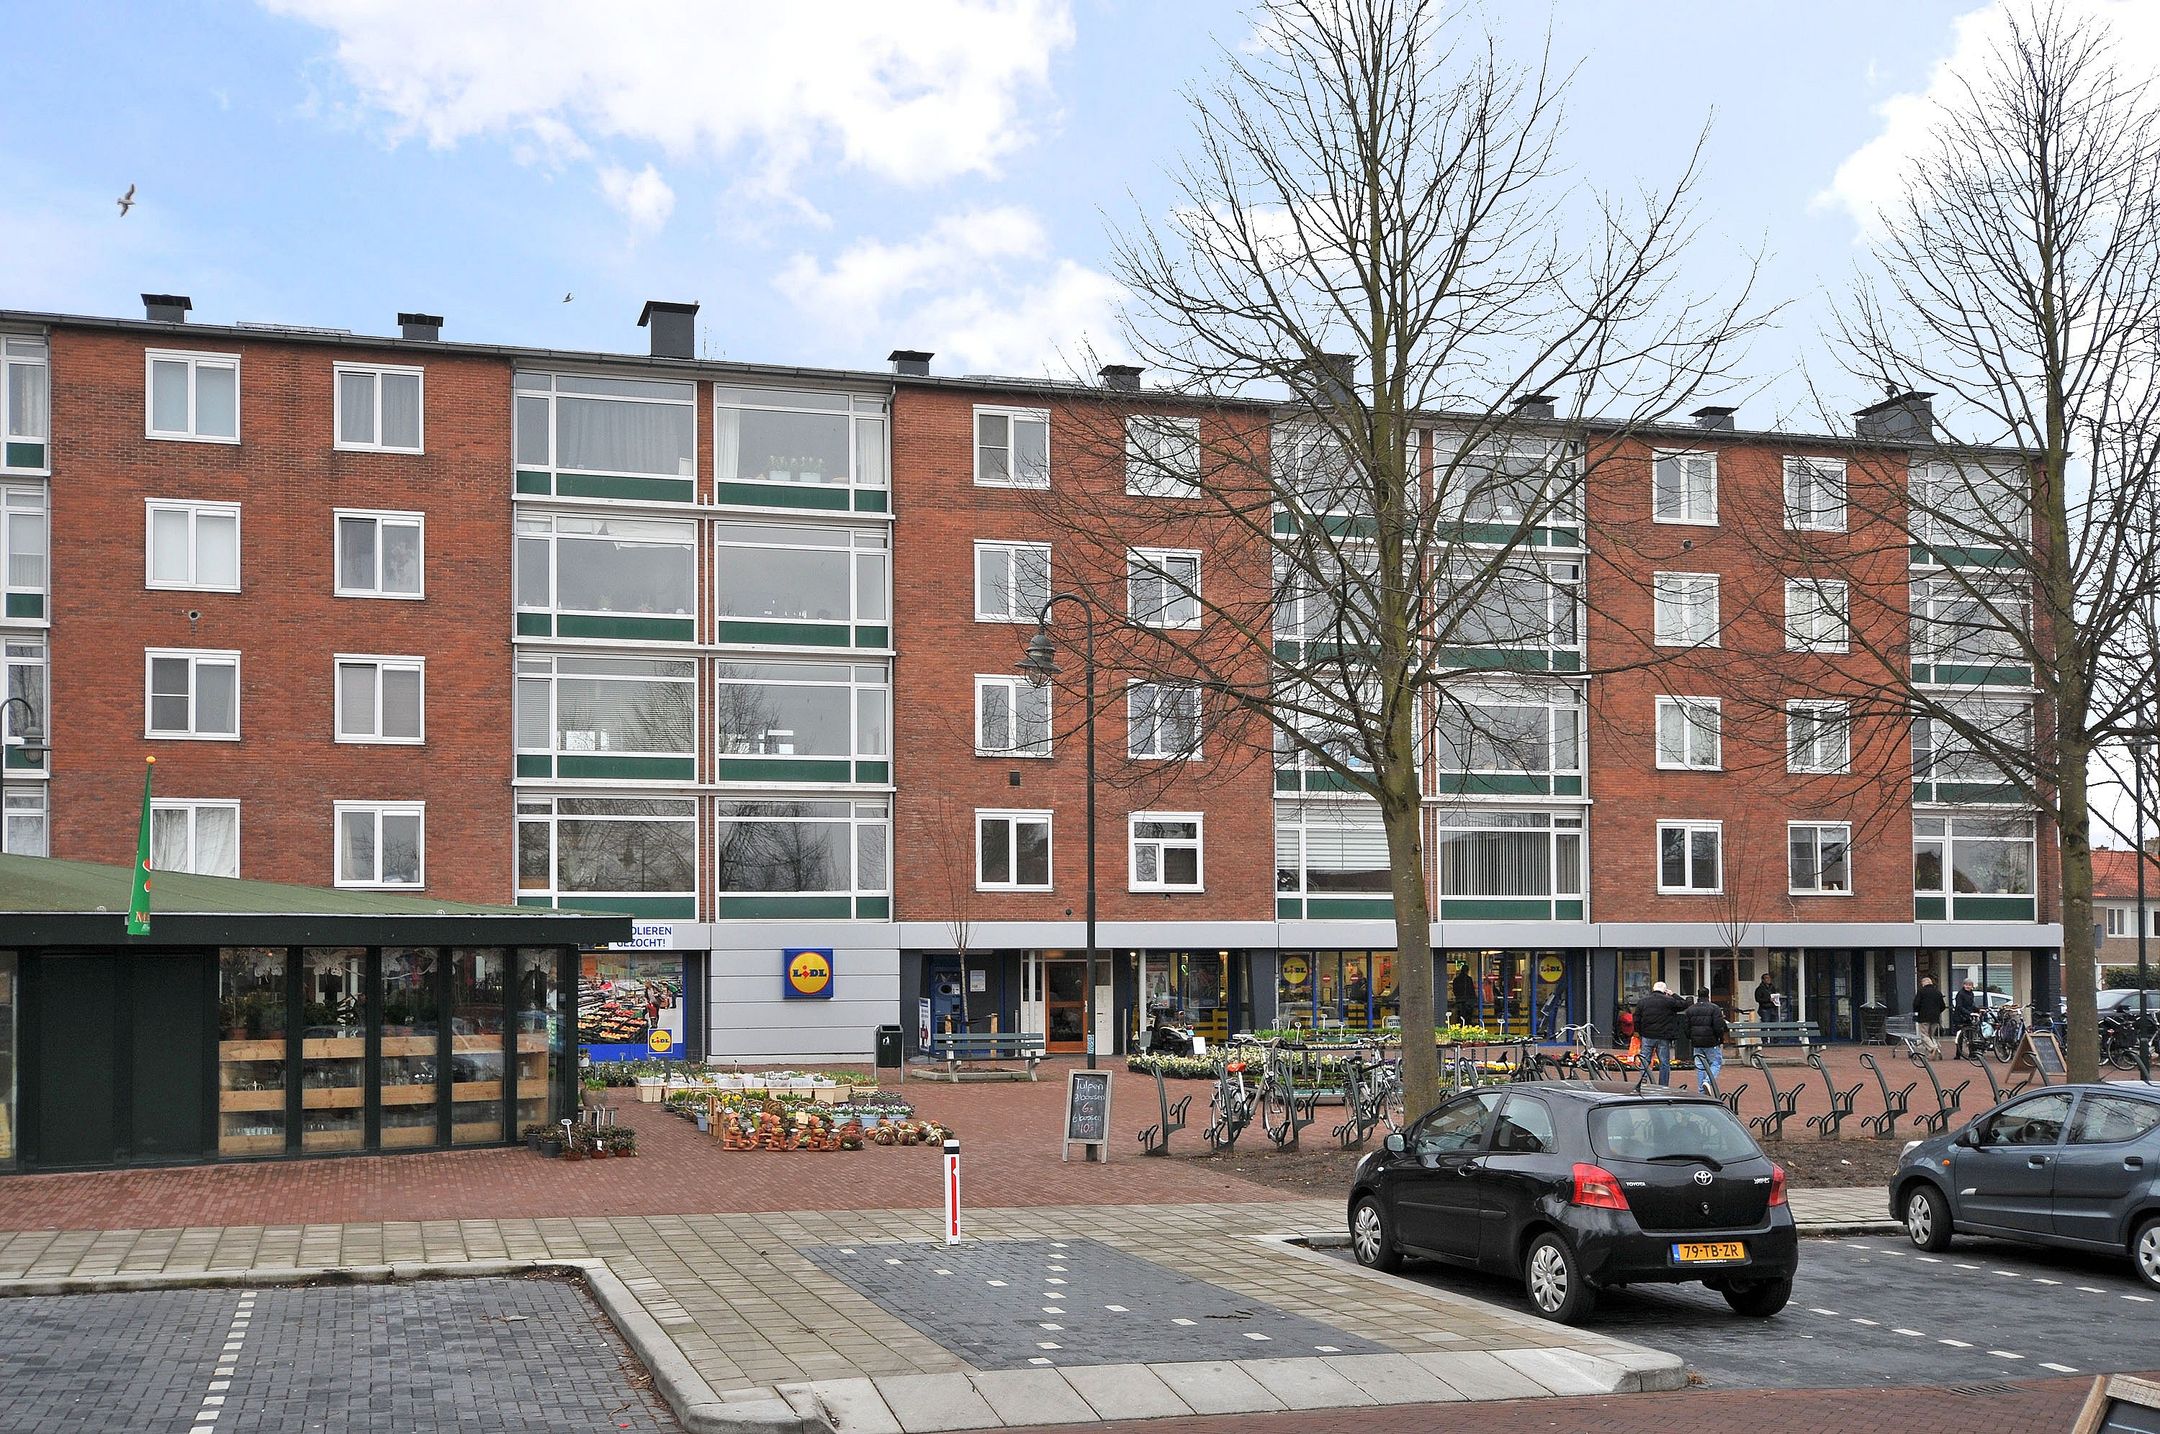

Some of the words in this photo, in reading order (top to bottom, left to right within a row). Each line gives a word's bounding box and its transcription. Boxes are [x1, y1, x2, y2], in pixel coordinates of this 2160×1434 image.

[632, 926, 672, 935] OLIEREN
[1075, 1077, 1104, 1092] Tulpen
[1684, 1244, 1739, 1258] 79-TB-ZR
